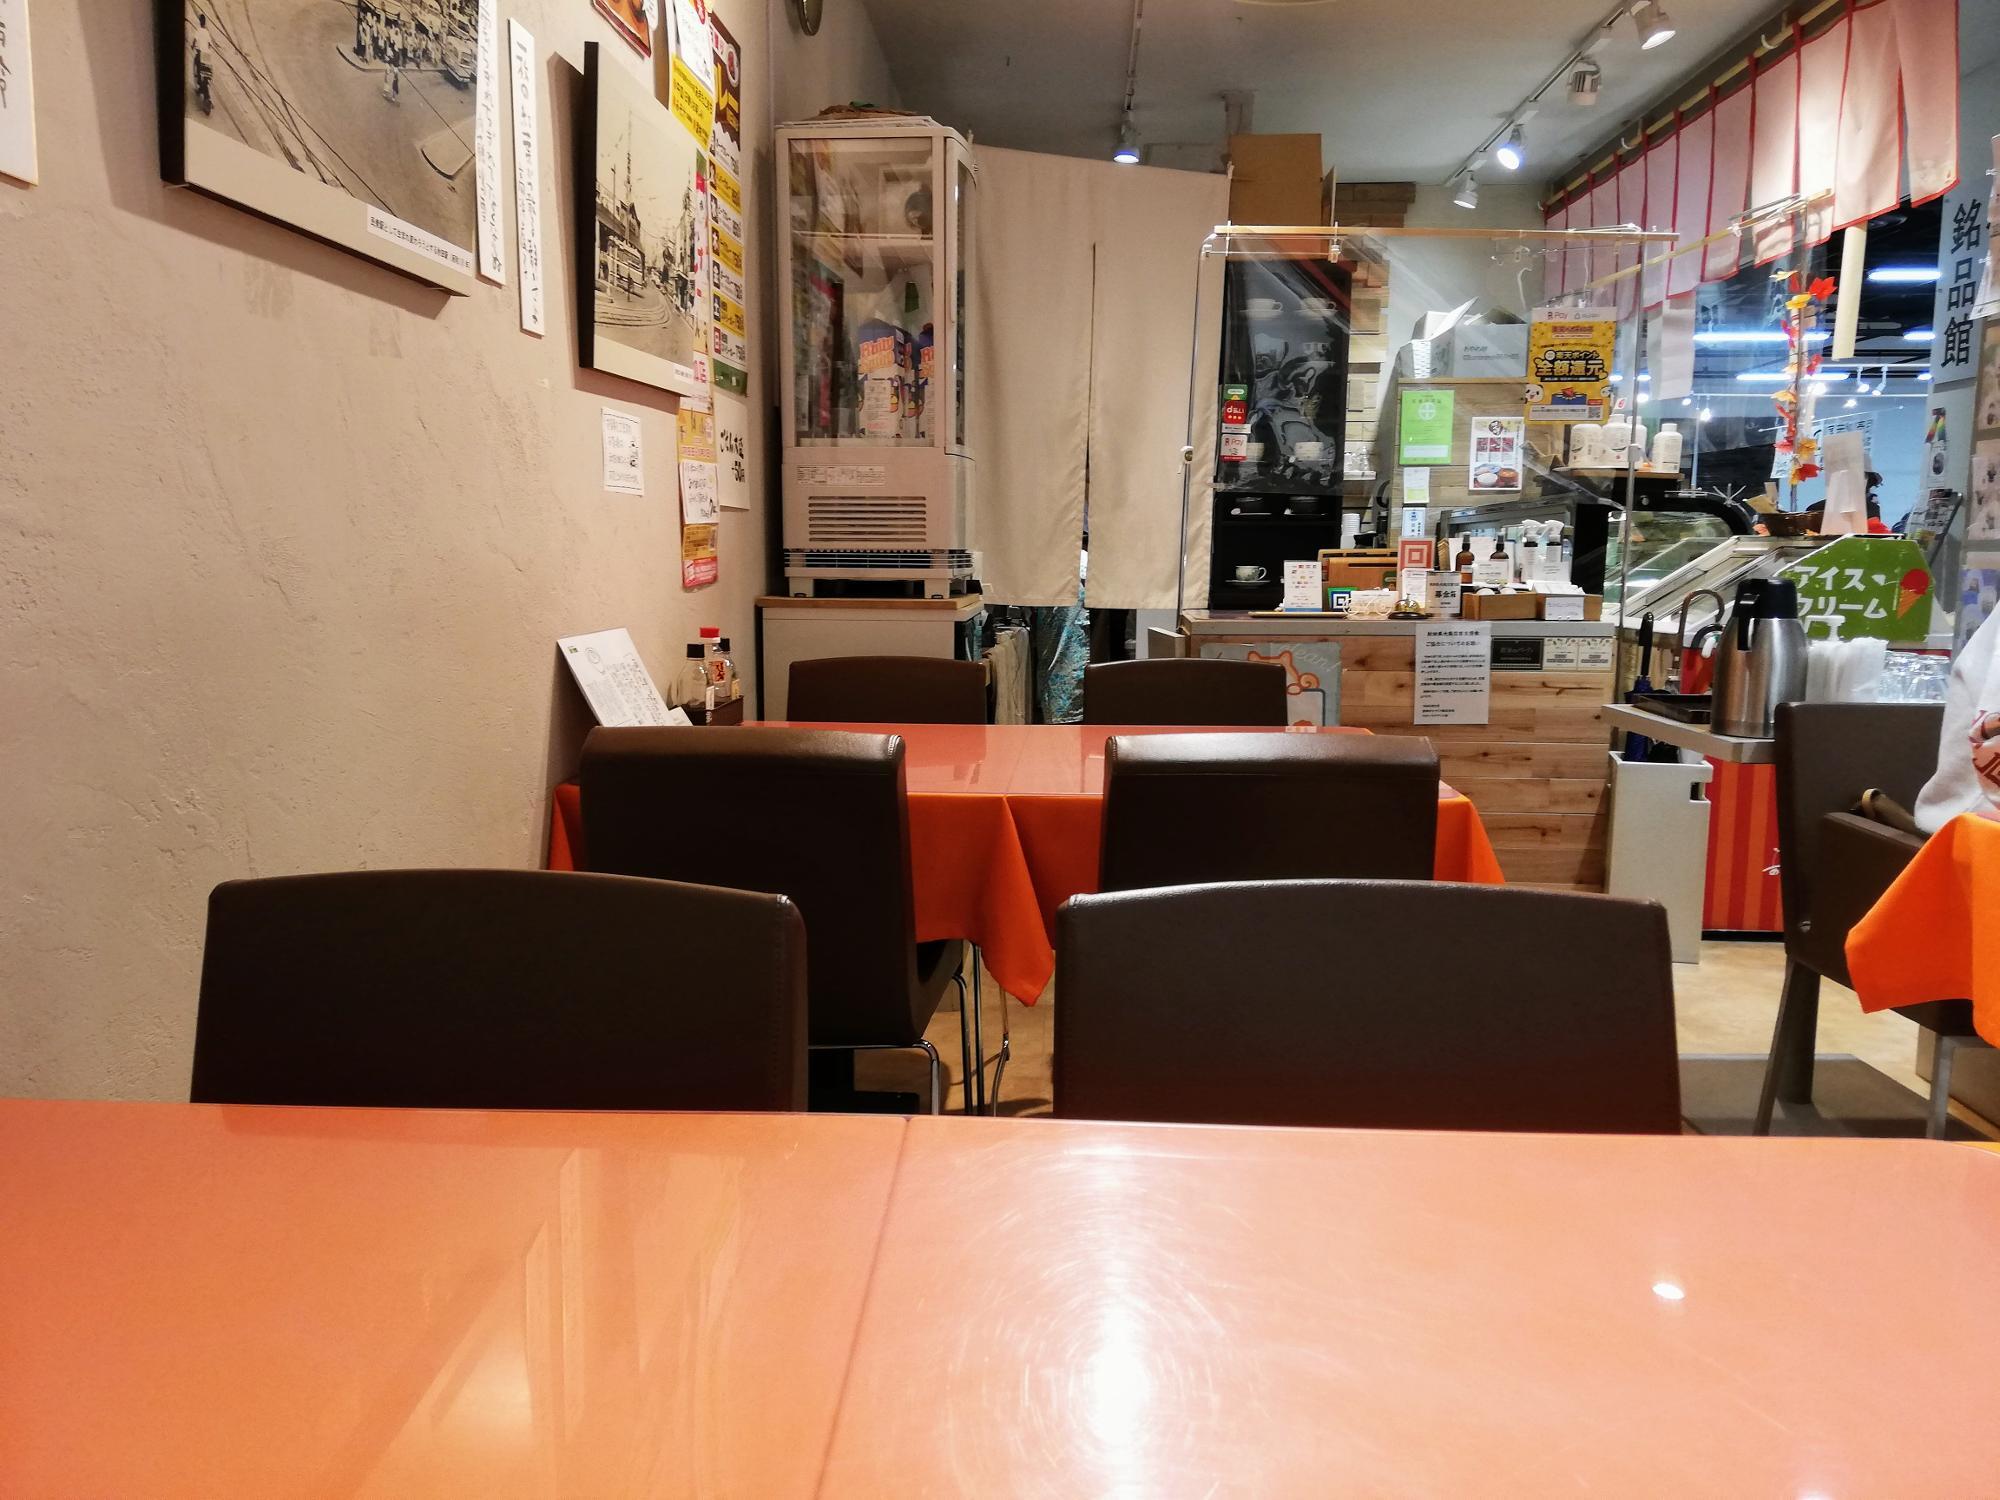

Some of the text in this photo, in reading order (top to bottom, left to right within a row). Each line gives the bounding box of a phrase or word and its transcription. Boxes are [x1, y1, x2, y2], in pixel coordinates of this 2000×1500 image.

[1941, 198, 1981, 368] 銘品館
[1556, 350, 1600, 359] 楽天ポイント
[1536, 359, 1604, 376] 全額還元
[1231, 438, 1244, 447] Pay
[1435, 590, 1457, 599] 募金箱
[1797, 593, 1888, 619] クリーム
